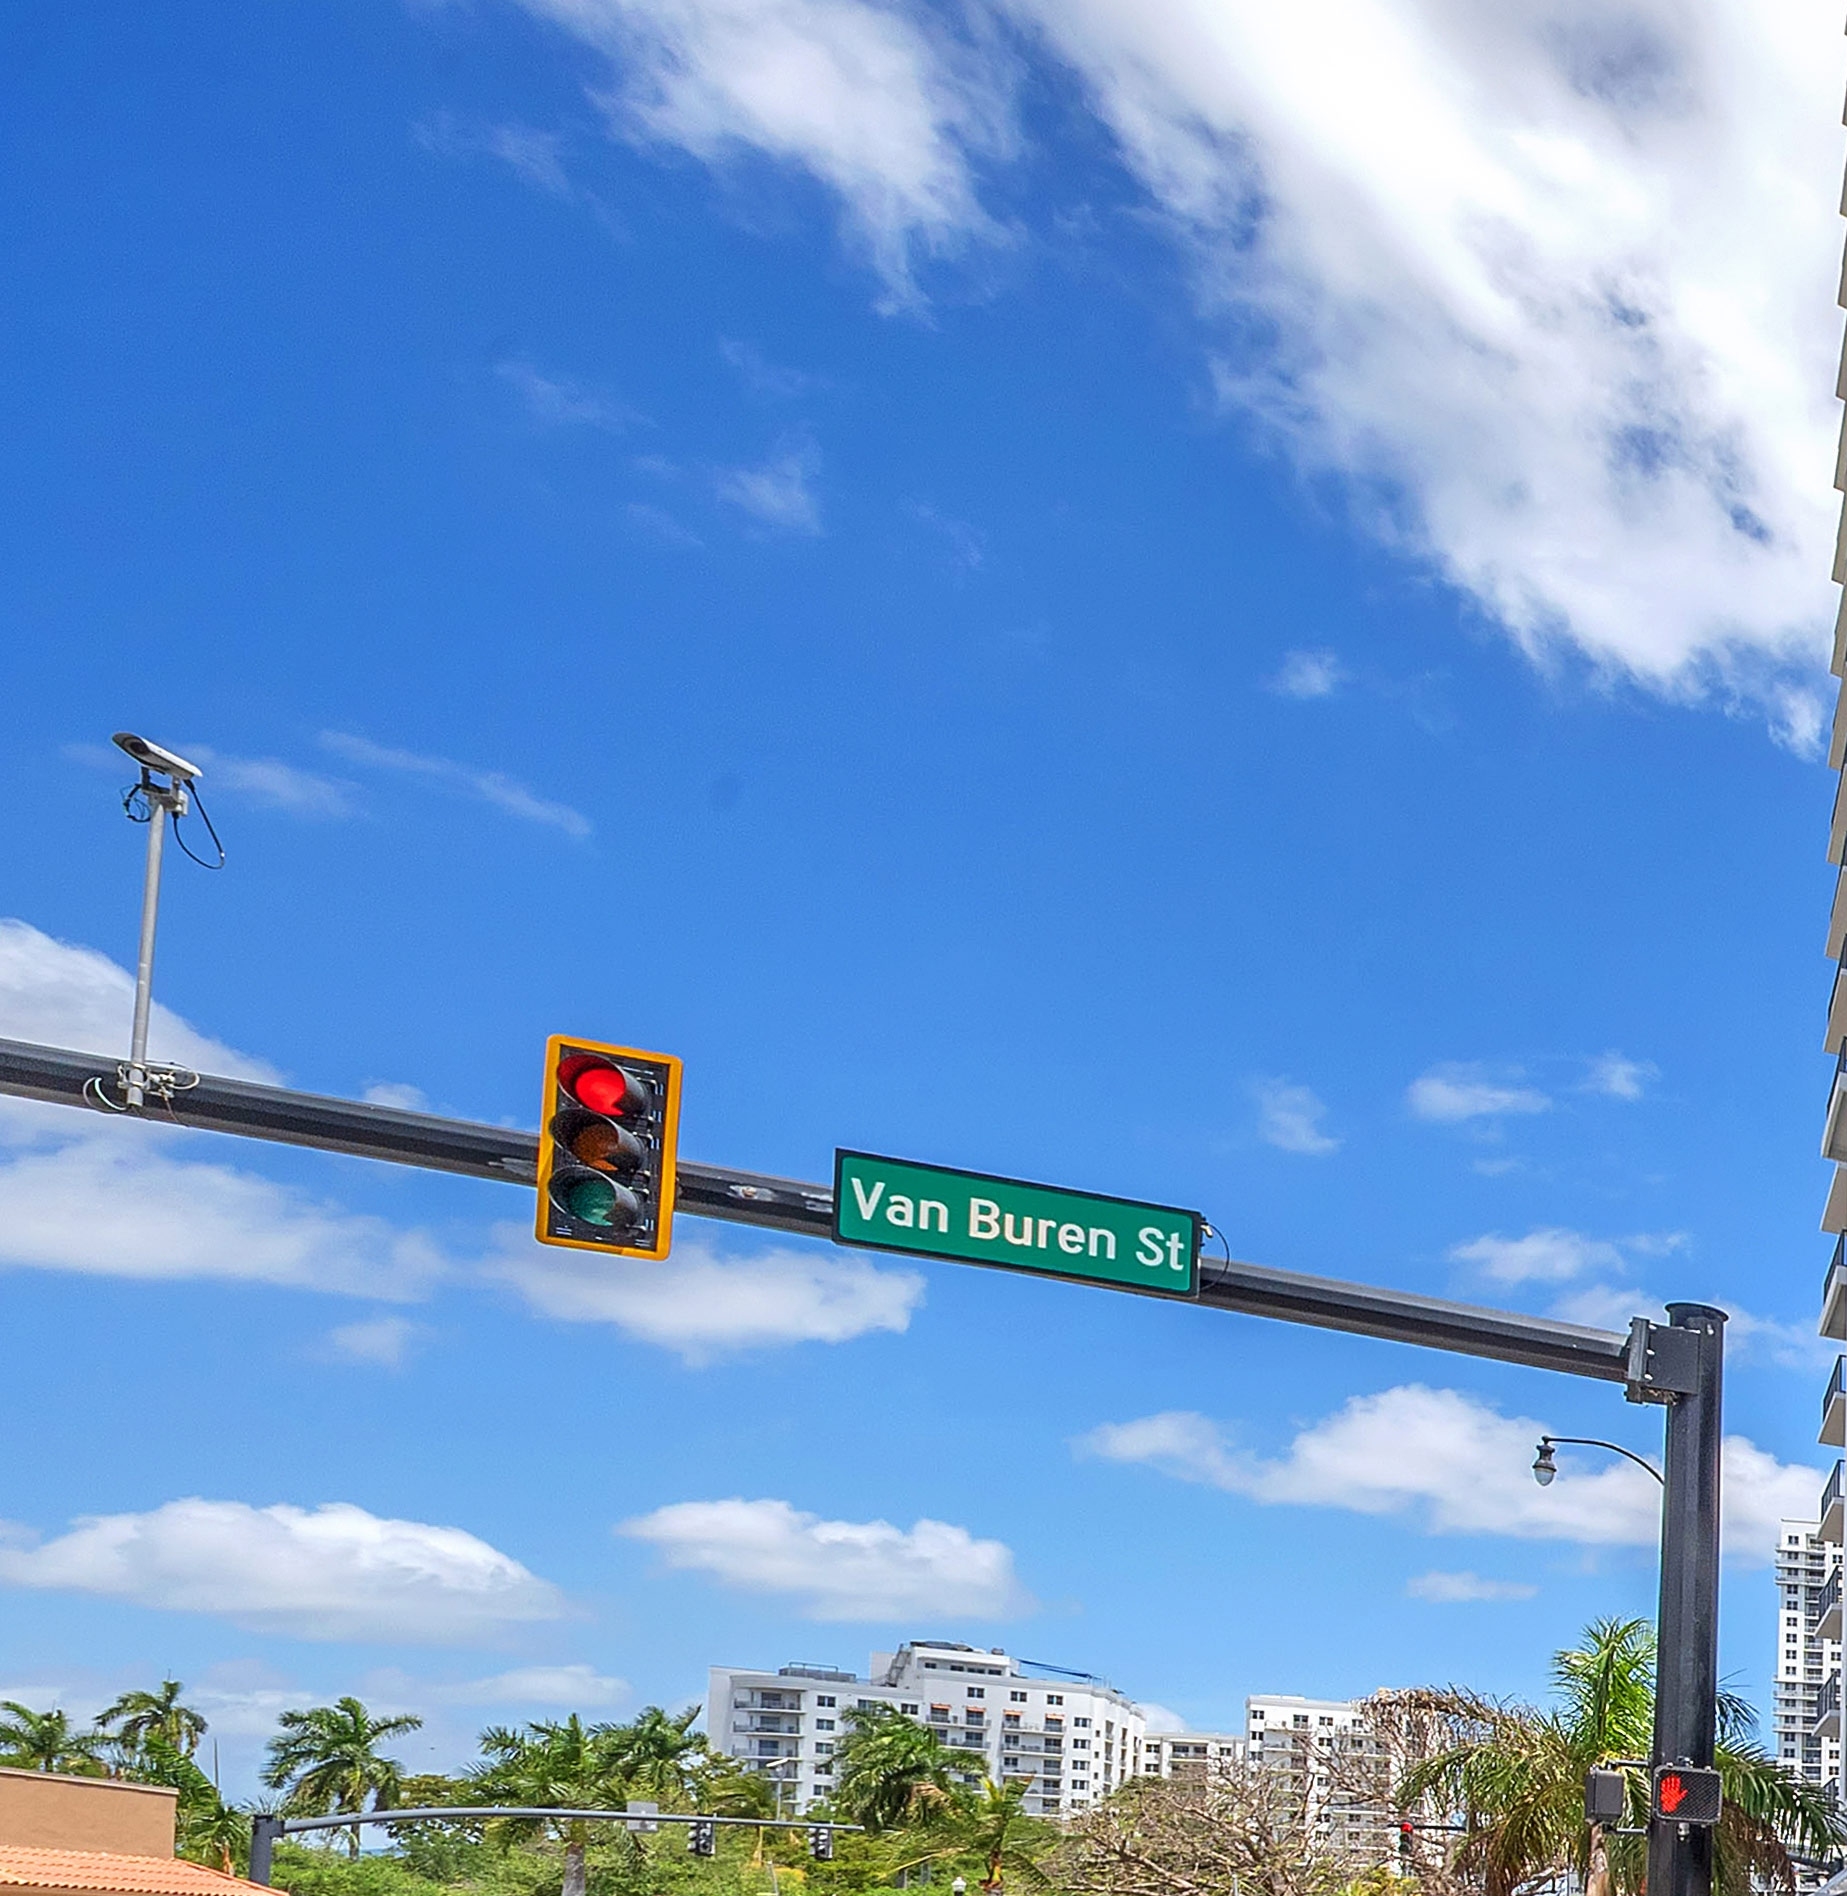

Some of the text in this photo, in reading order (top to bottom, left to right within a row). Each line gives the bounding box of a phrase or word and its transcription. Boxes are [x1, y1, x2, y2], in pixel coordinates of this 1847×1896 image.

[851, 1177, 1184, 1271] Van Buren St
